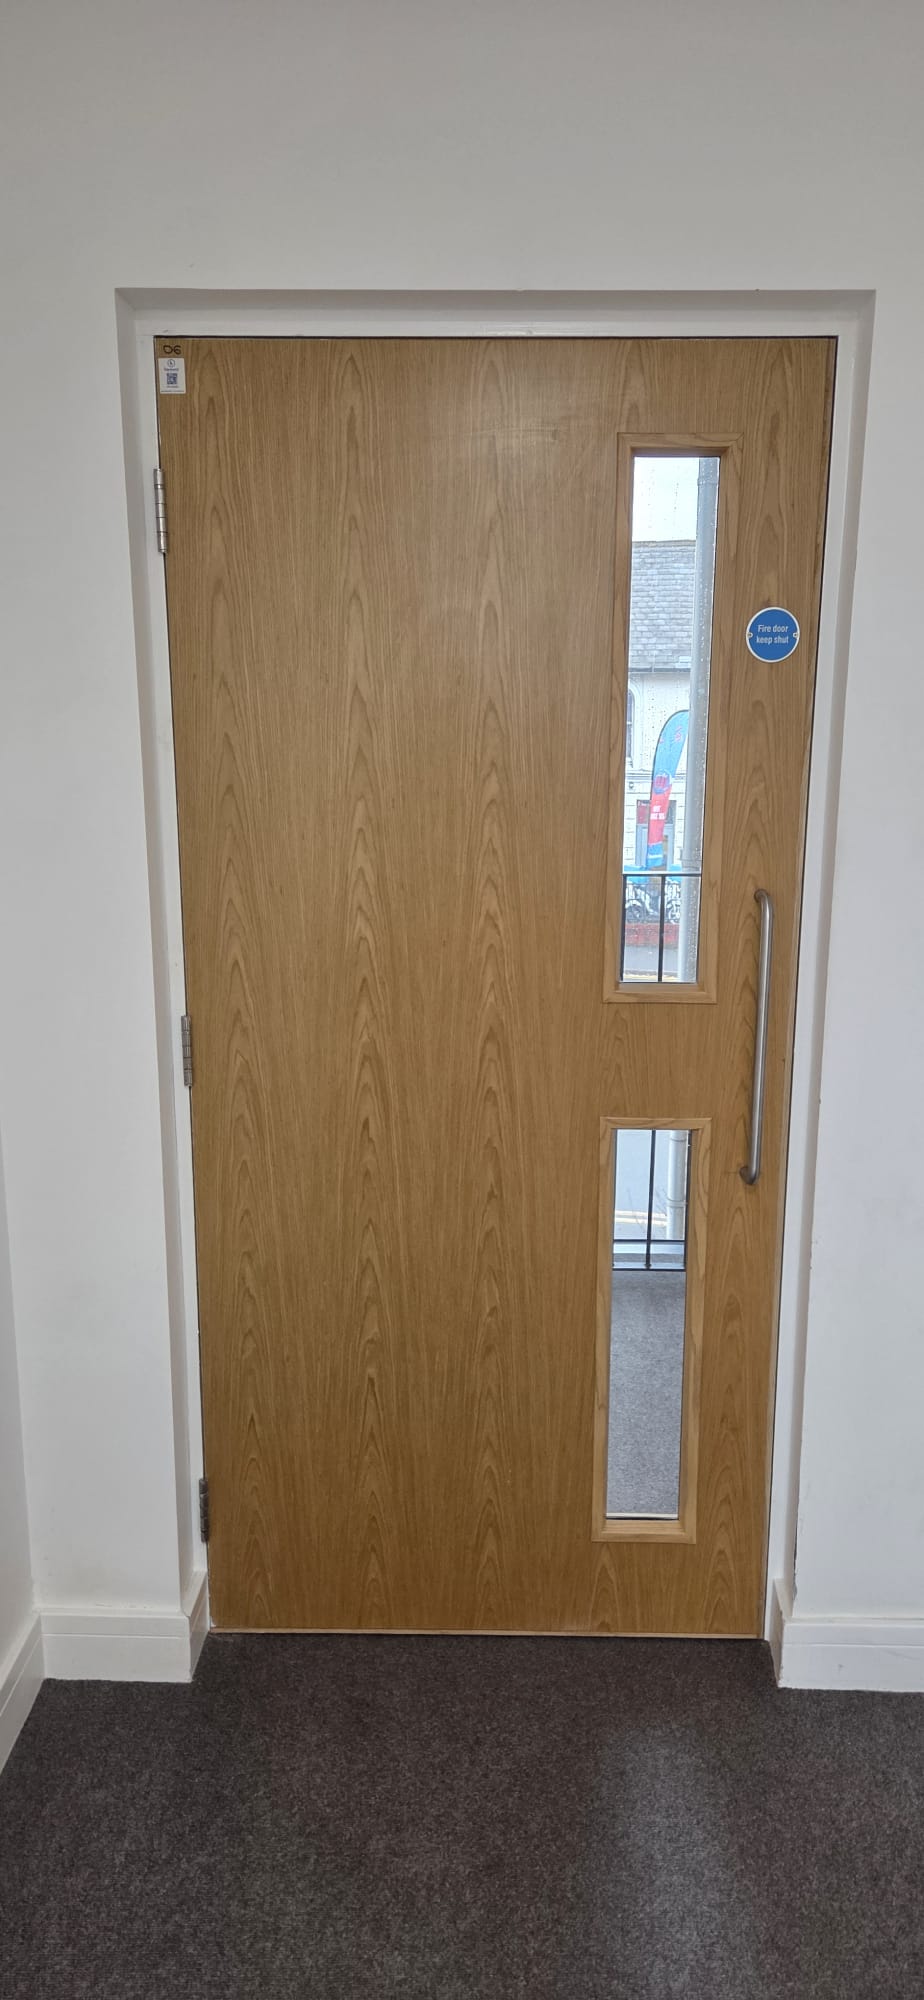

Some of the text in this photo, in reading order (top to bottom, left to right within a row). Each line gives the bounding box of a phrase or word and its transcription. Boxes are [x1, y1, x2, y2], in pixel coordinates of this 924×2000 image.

[758, 624, 789, 633] Fire door
[756, 635, 789, 646] keep shut
